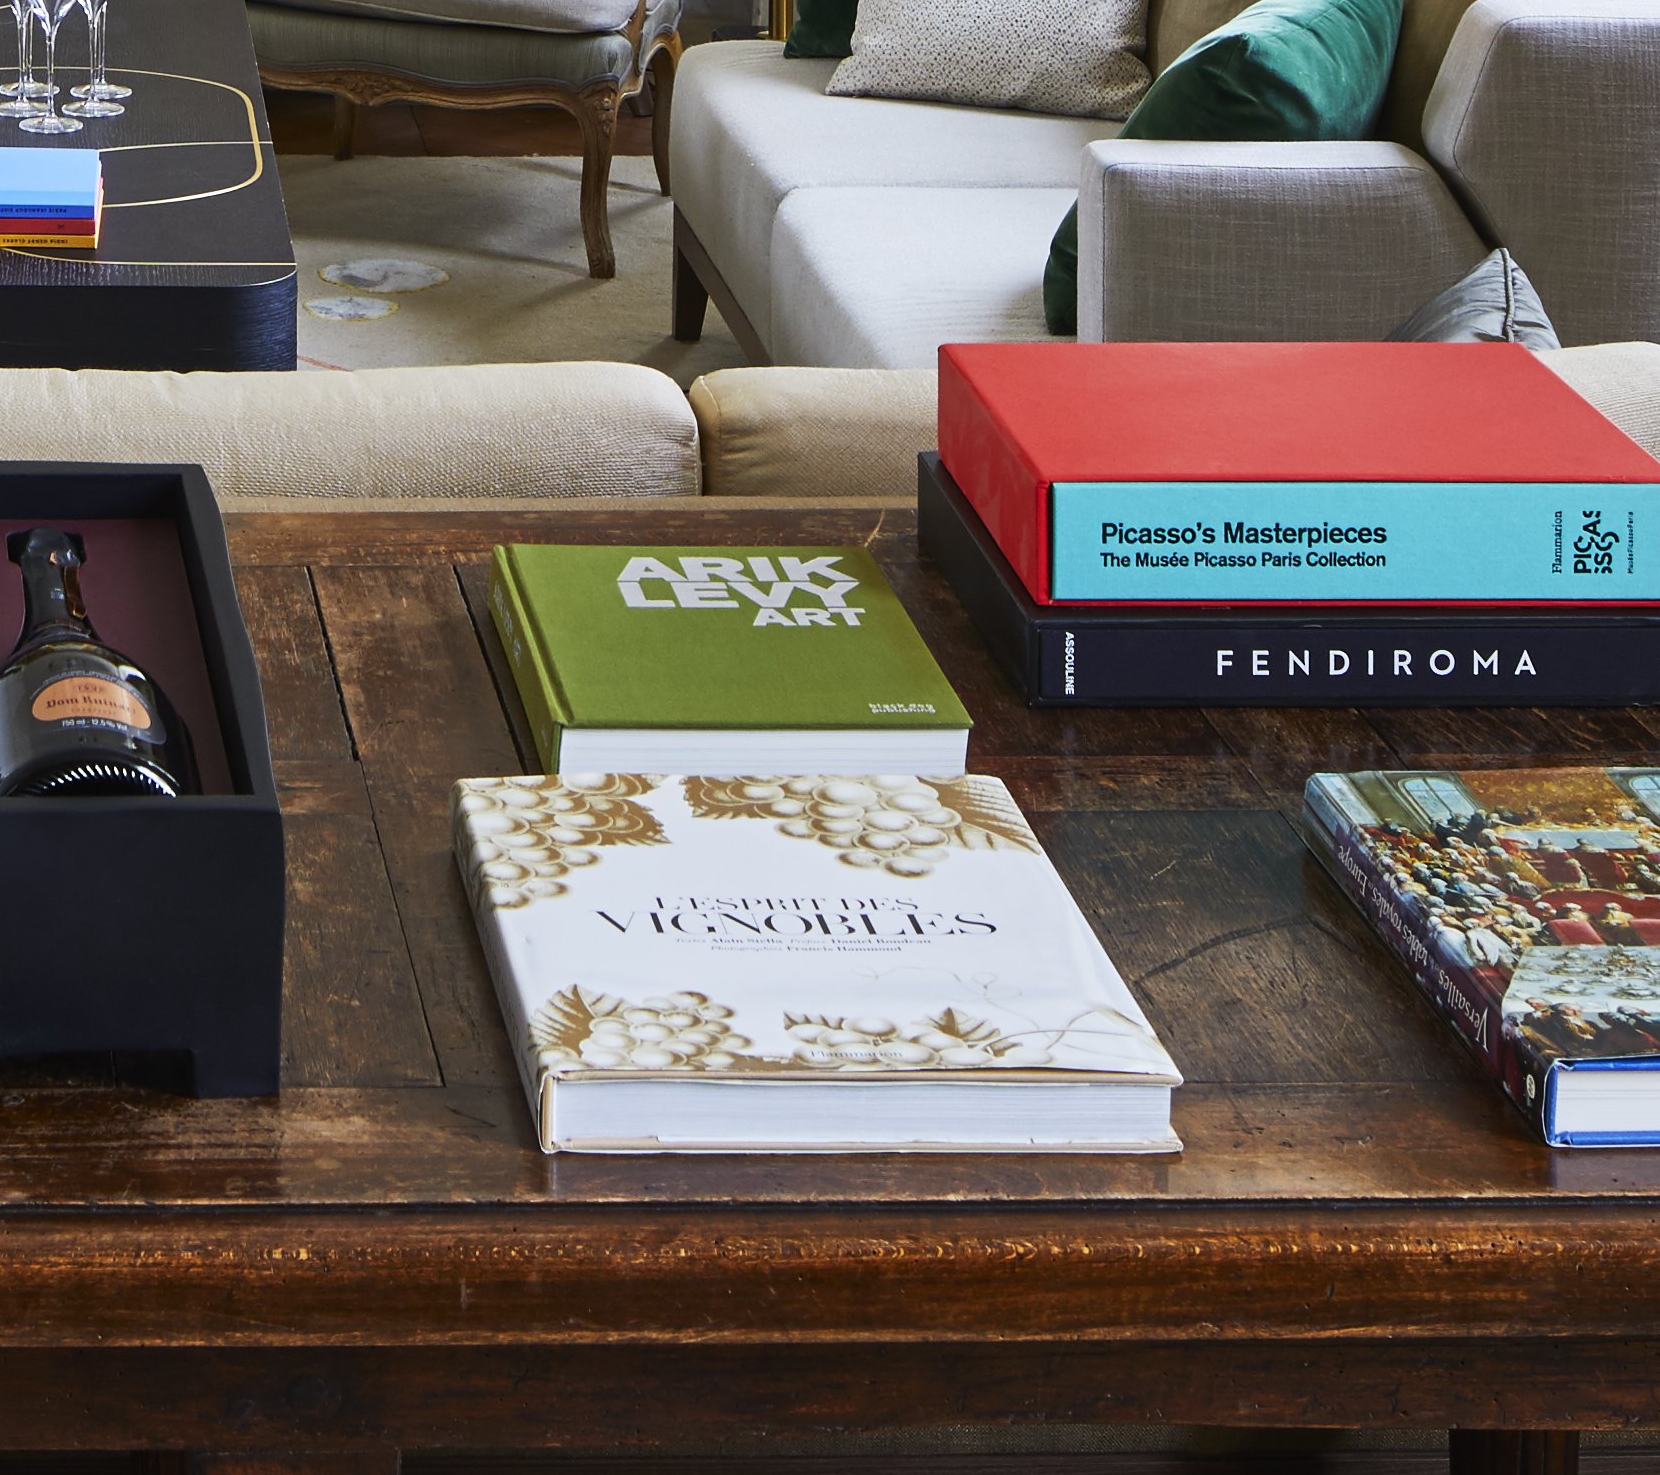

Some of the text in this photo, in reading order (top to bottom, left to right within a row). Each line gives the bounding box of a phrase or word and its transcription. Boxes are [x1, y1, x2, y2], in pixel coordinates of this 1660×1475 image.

[1101, 521, 1387, 549] Picasso's Masterpieces
[1551, 510, 1564, 575] Flammarion
[616, 556, 858, 584] ARIK
[1100, 552, 1387, 568] The Musée Picasso Paris Collection
[619, 581, 860, 608] LEVY
[752, 608, 866, 627] ART
[1064, 631, 1075, 696] ASSOULINE
[46, 696, 79, 709] Dom
[655, 897, 919, 911] L'ESPRIT DES
[595, 910, 998, 936] VIGNOBLES
[1337, 844, 1489, 1053] Versailles tables royales Europe
[811, 1050, 904, 1058] Flammarion
